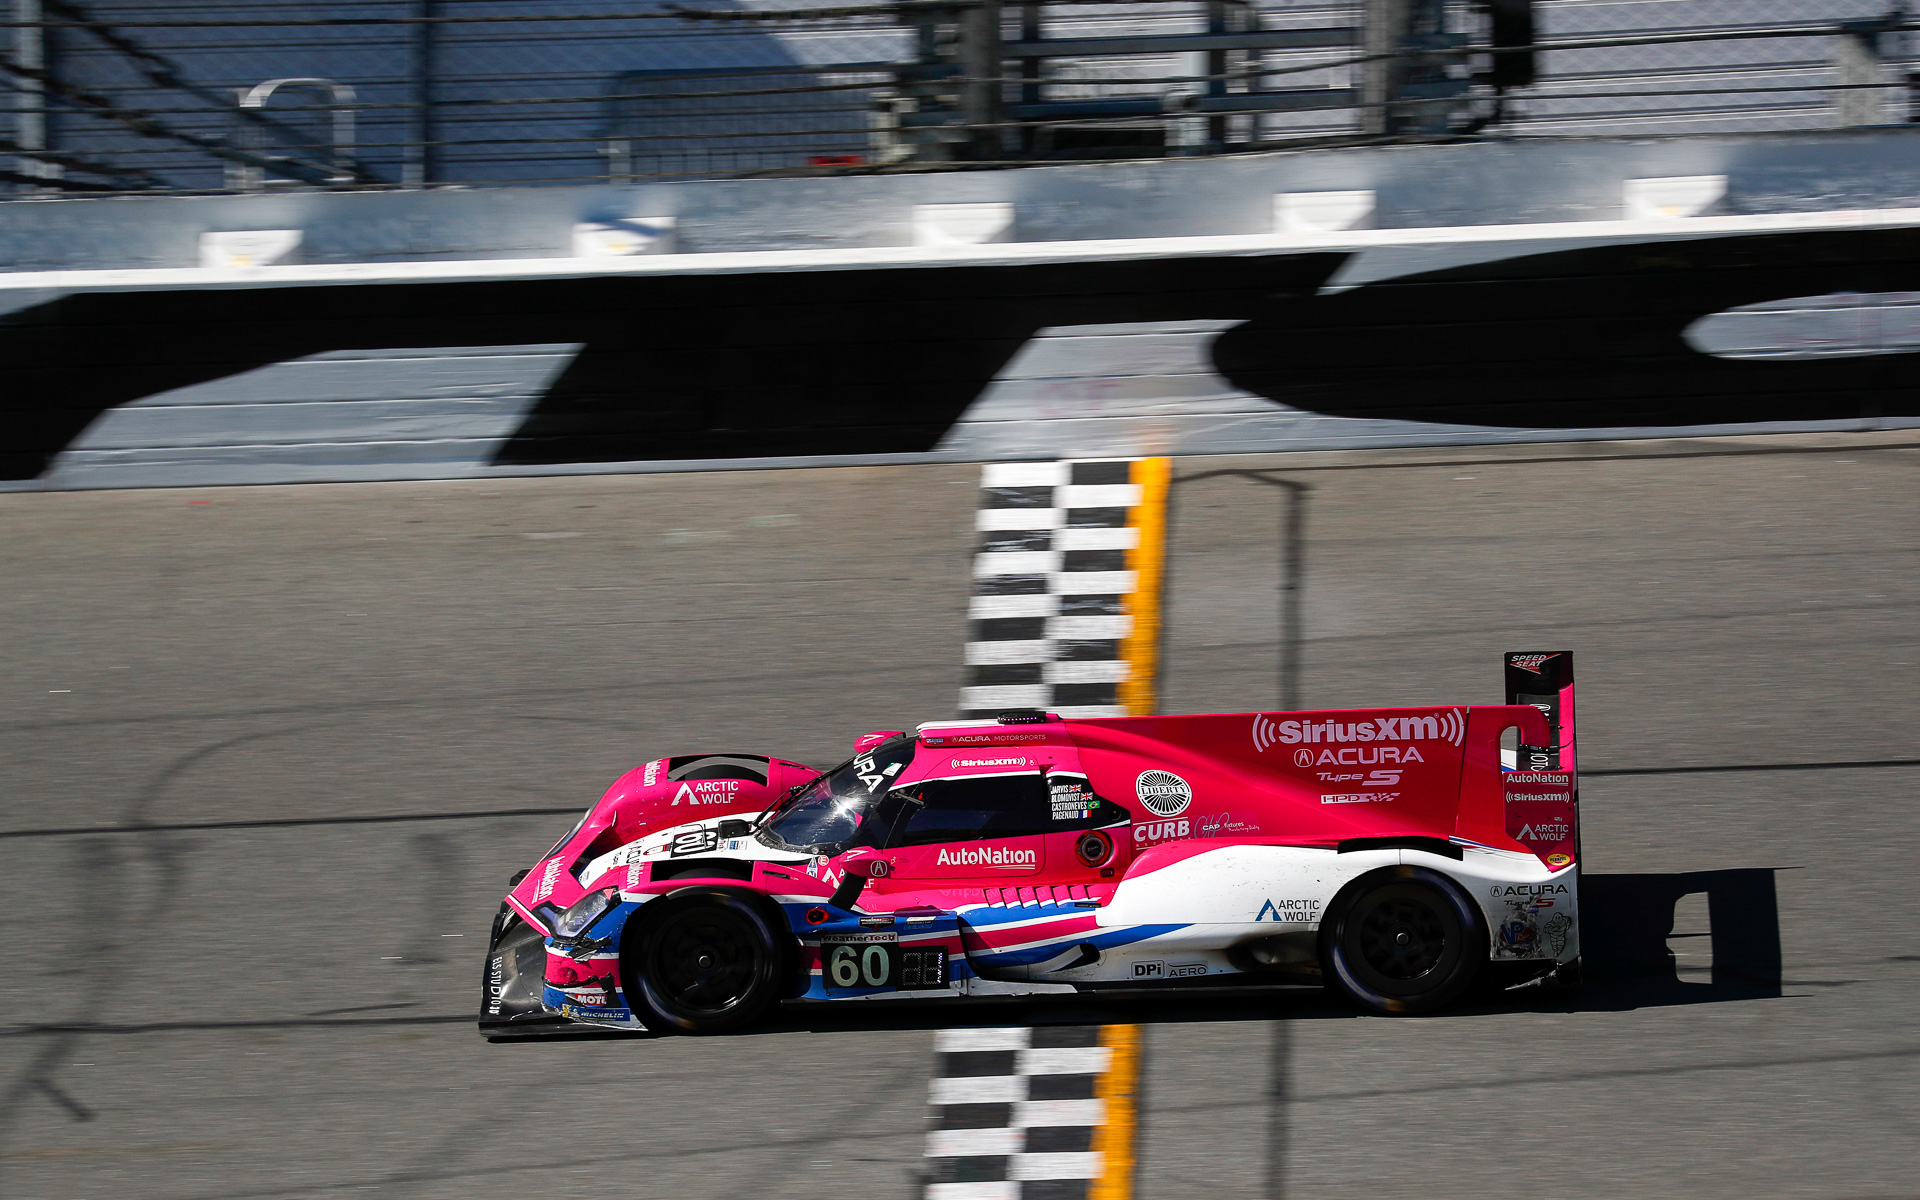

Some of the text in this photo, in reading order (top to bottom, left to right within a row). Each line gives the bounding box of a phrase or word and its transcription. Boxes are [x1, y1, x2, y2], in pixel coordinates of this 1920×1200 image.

[1511, 654, 1547, 662] SPEED
[1316, 747, 1424, 766] ACURA
[1316, 769, 1404, 786] Type S
[1506, 773, 1569, 783] AutoNation
[695, 781, 739, 792] ARCTIC
[1050, 785, 1069, 794] JARVIS
[1141, 785, 1187, 795] LIBERTY
[701, 793, 736, 804] WOLF
[1323, 795, 1361, 803] HPD
[1051, 801, 1088, 811] CASTRONEVES
[1052, 810, 1079, 820] PAGENAUD
[1133, 820, 1190, 842] CURB
[1535, 824, 1569, 832] ARCTIC
[1540, 833, 1566, 841] WOLF
[937, 846, 1036, 865] AutoNation
[1504, 884, 1568, 896] ACURA
[1278, 900, 1320, 910] ARCTIC
[1284, 912, 1317, 921] WOLF
[491, 956, 503, 970] ELS
[831, 945, 890, 987] 60
[1134, 963, 1207, 977] DPi AERO
[581, 1011, 625, 1019] MICHELIN
